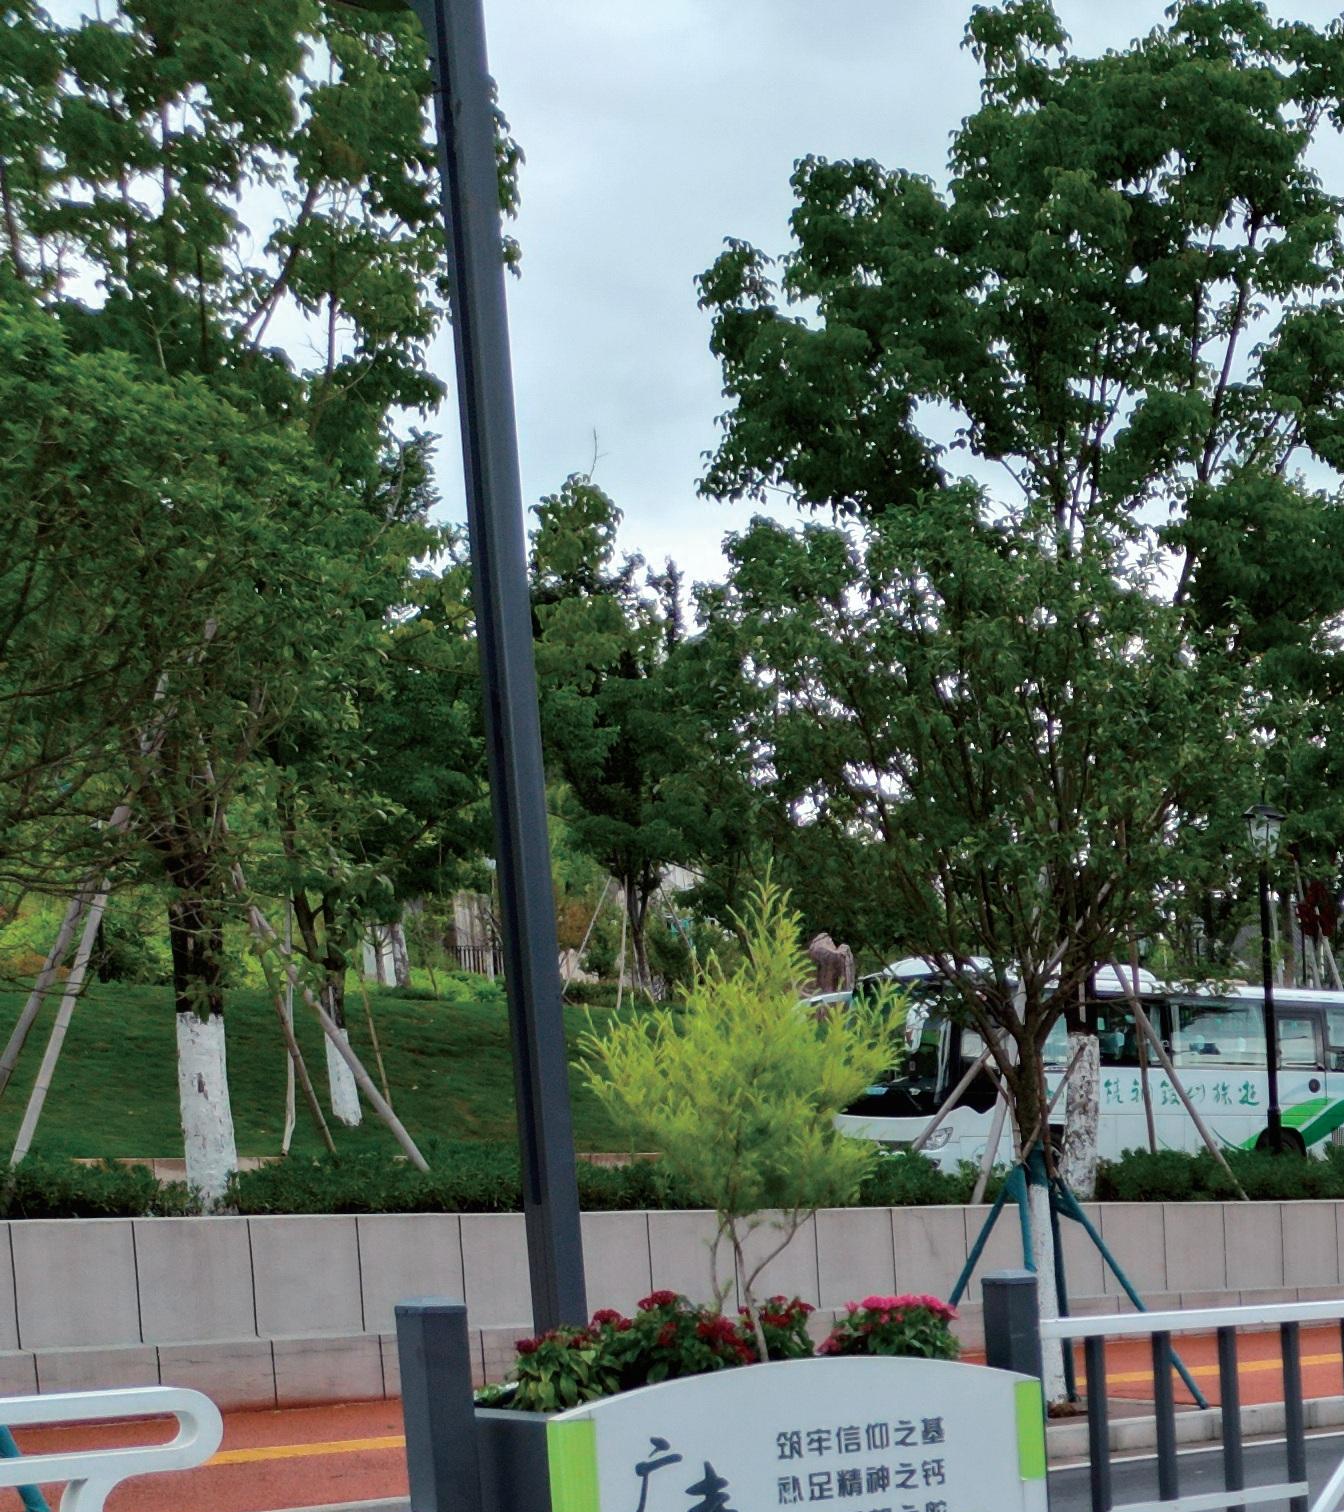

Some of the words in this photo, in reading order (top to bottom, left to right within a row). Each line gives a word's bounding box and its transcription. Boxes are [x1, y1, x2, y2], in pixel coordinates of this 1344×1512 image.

[776, 1416, 946, 1460] 筑牢信仰之基
[777, 1458, 946, 1505] 补足精神之钙
